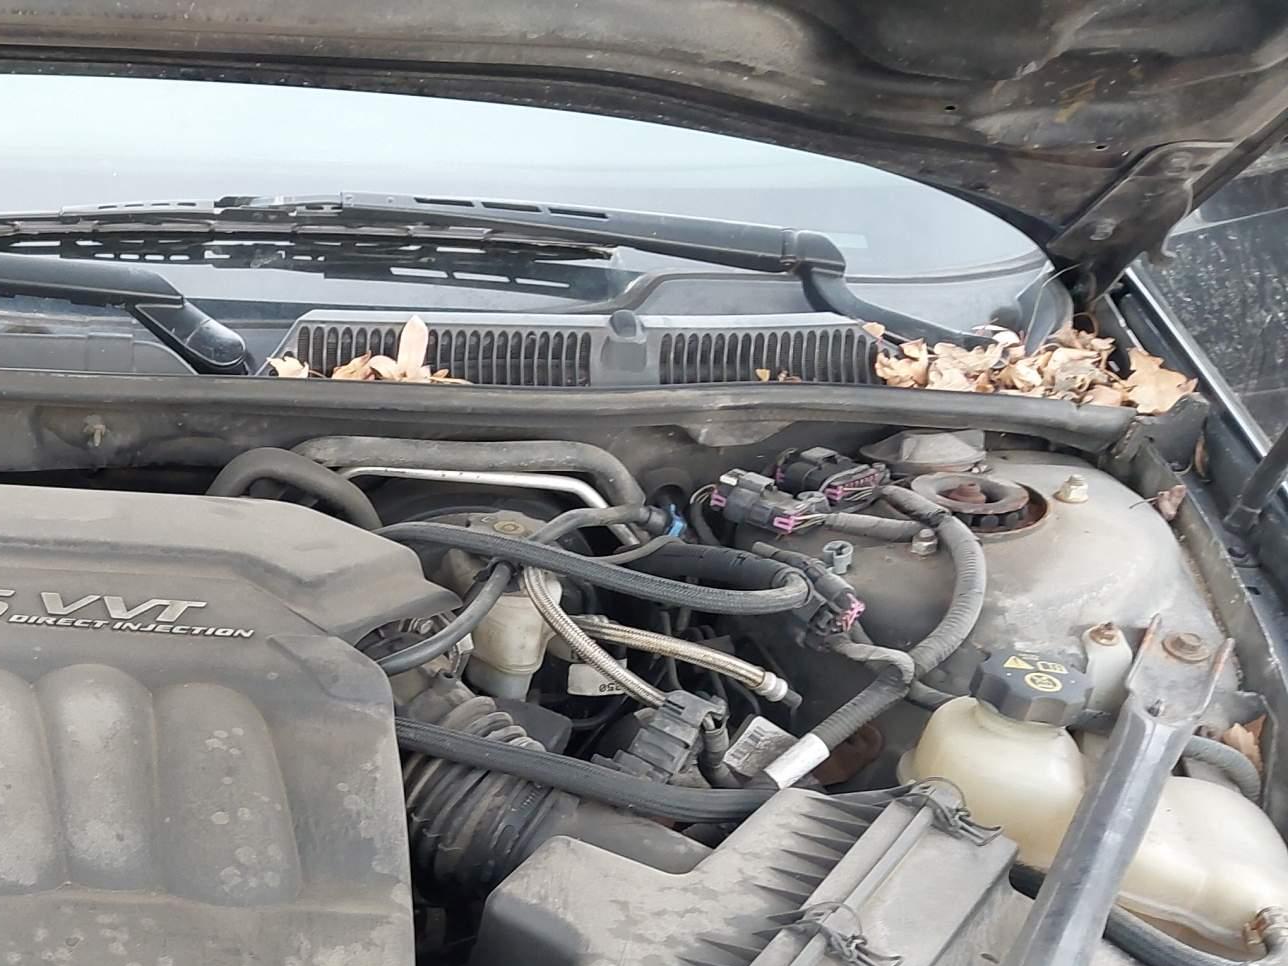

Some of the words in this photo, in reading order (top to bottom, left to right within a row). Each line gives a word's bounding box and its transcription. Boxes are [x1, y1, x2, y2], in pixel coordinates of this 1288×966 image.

[40, 591, 208, 622] VVT
[8, 613, 110, 629] DIRECT
[112, 621, 254, 638] INJECTION
